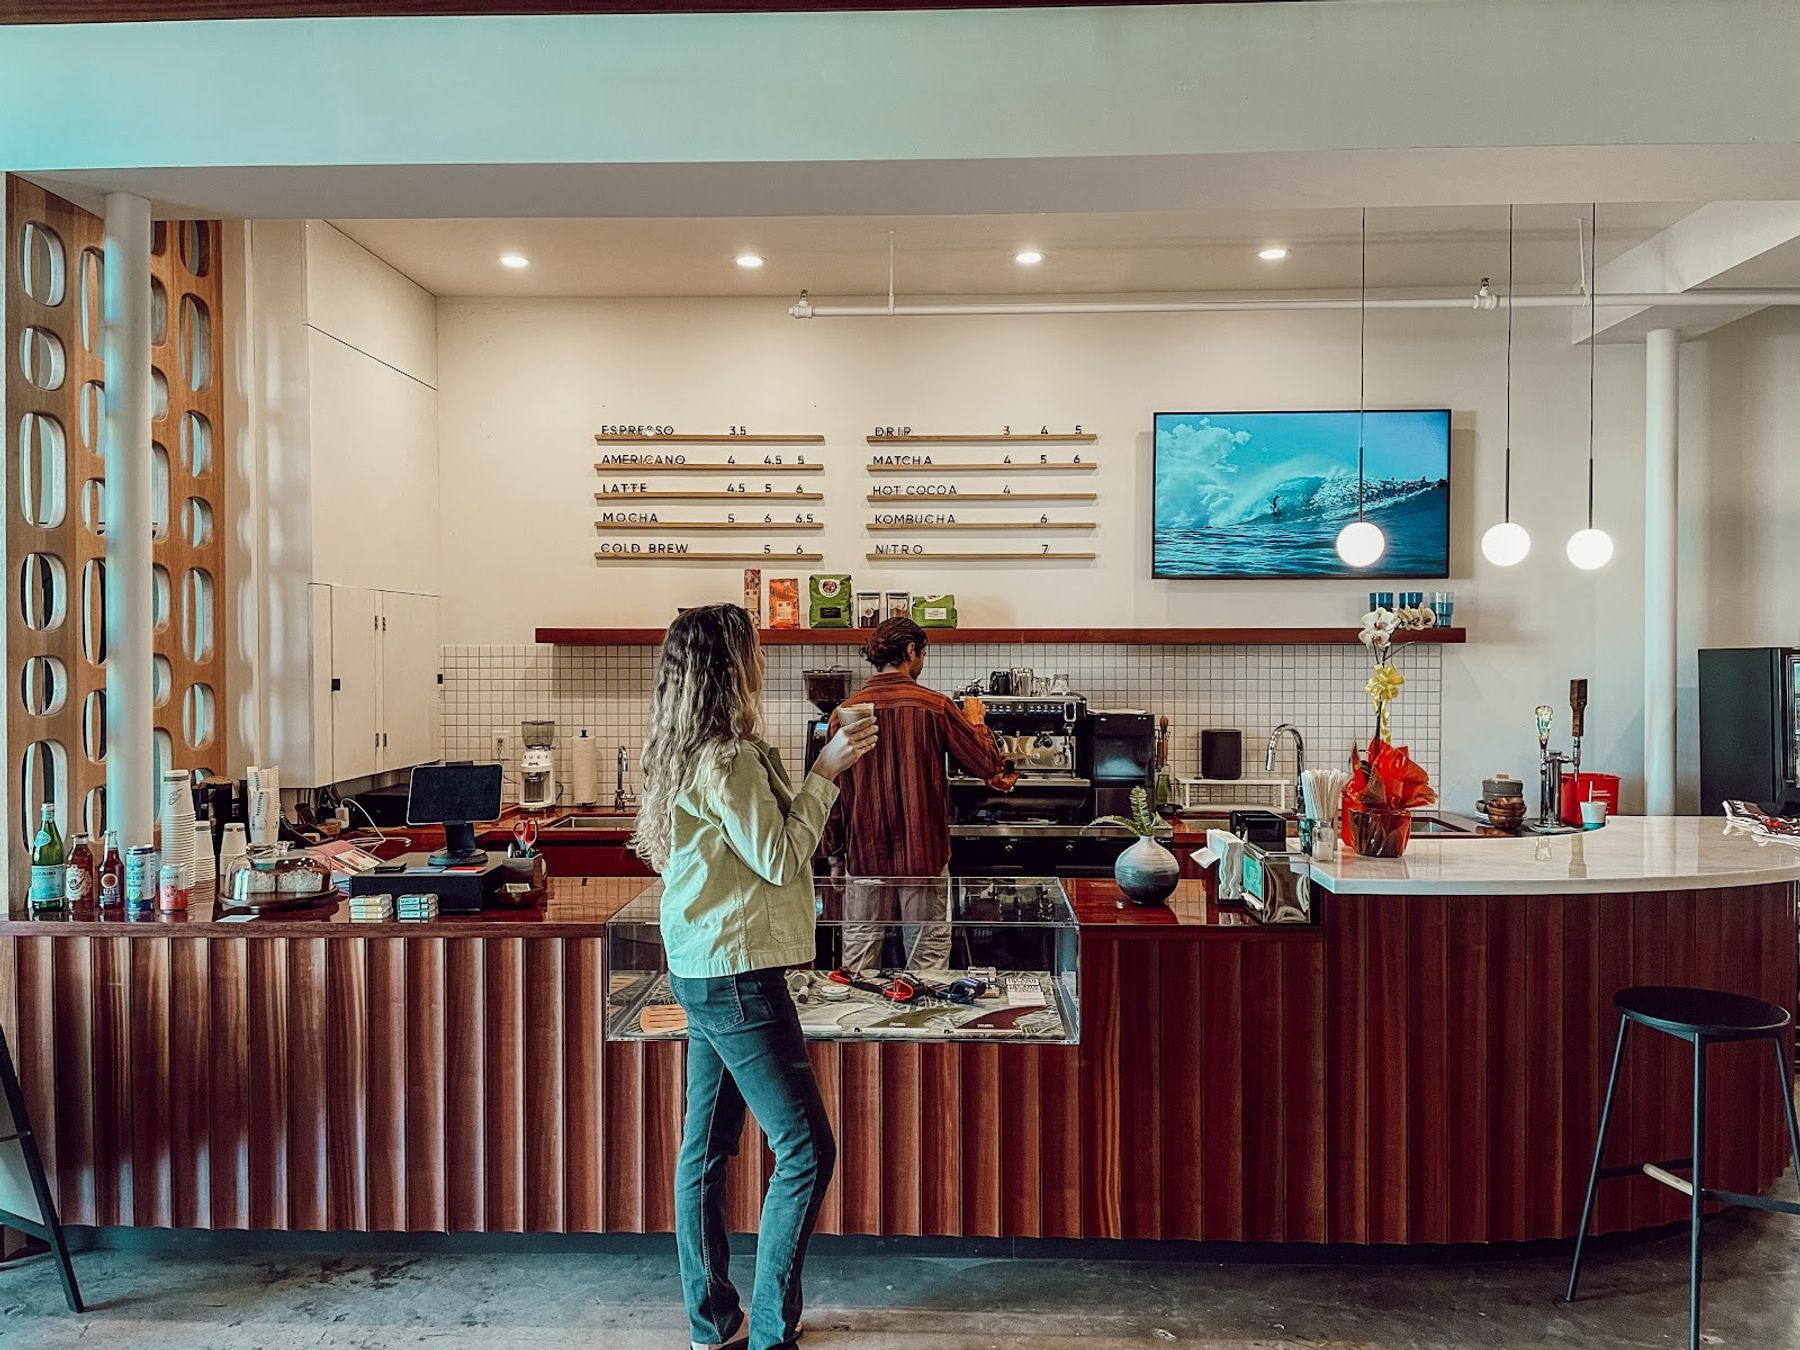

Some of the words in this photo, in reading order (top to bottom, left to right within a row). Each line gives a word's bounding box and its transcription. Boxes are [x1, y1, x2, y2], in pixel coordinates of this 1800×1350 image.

[601, 425, 675, 436] ESPRESSO
[729, 425, 747, 436] 3.5
[874, 426, 912, 437] DRIP
[1003, 425, 1011, 435] 3
[1040, 425, 1048, 435] 4
[1074, 425, 1082, 435] 5
[601, 454, 686, 465] AMERICANO
[727, 455, 736, 465] 4
[763, 455, 782, 465] 4.5
[797, 455, 805, 465] 5
[872, 455, 933, 465] MATCHA
[1003, 455, 1012, 464] 4
[1040, 455, 1048, 464] 5
[1073, 455, 1081, 464] 6
[602, 483, 647, 494] LATTE
[726, 483, 745, 493] 4.5
[764, 483, 772, 493] 5
[796, 484, 804, 494] 6
[872, 485, 901, 495] HOT
[905, 485, 958, 495] COCOA
[1003, 484, 1011, 495] 4
[602, 512, 659, 523] MOCHA
[727, 513, 735, 523] 5
[764, 513, 772, 523] 6
[795, 513, 814, 523] 6.5
[875, 514, 956, 525] KOMBUCHA
[1040, 514, 1048, 524] 6
[600, 543, 641, 554] COLD
[648, 543, 689, 554] BREW
[763, 544, 771, 554] 5
[795, 544, 804, 554] 6
[874, 544, 923, 555] NITRO
[1041, 544, 1049, 555] 7
